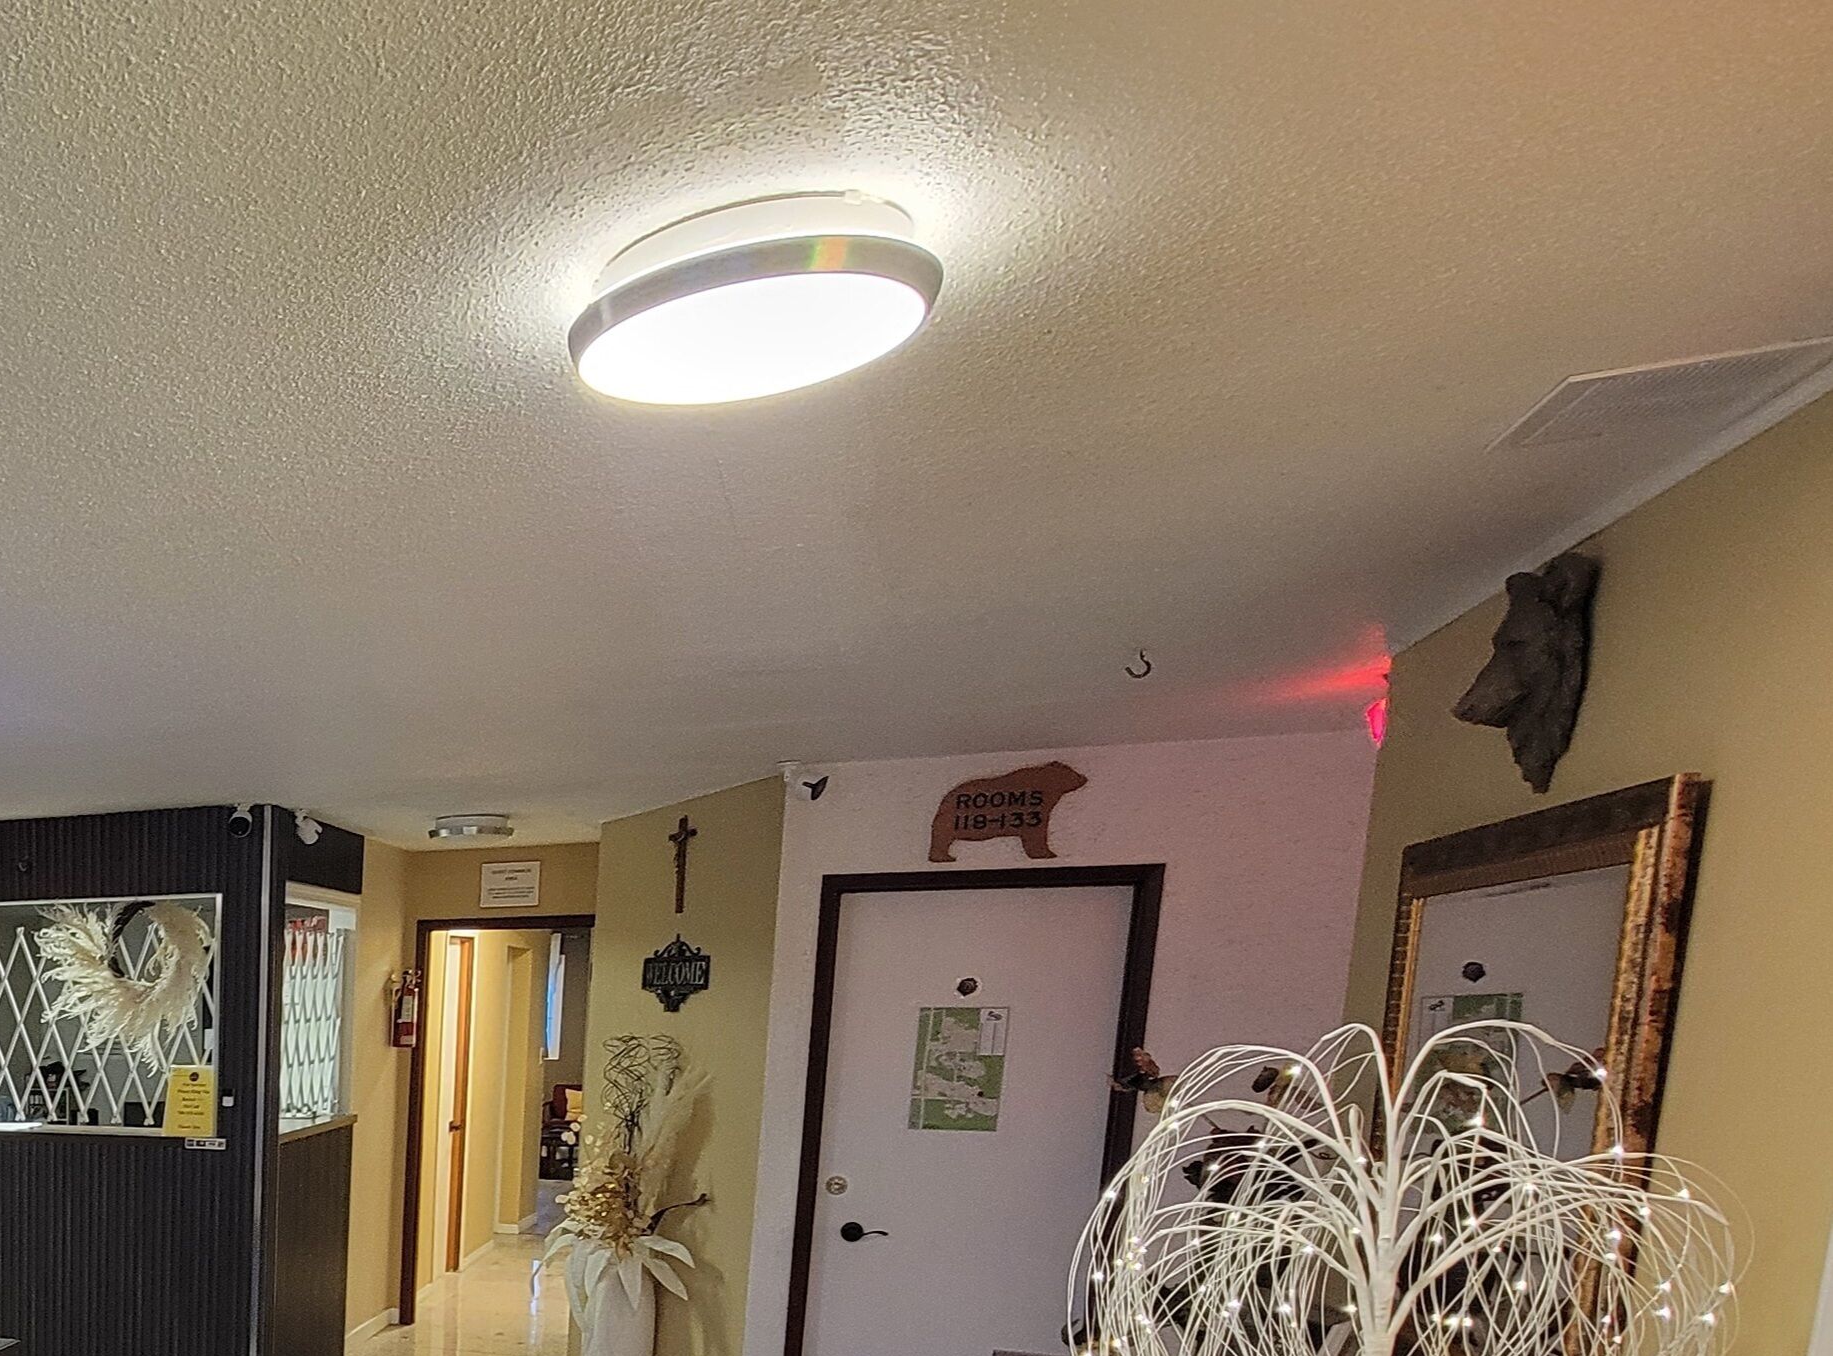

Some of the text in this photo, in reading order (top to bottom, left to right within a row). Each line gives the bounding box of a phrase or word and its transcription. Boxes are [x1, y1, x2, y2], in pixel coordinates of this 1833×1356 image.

[956, 791, 1043, 809] ROOMS
[954, 811, 1042, 830] 118-133
[646, 961, 706, 985] WELCOME
